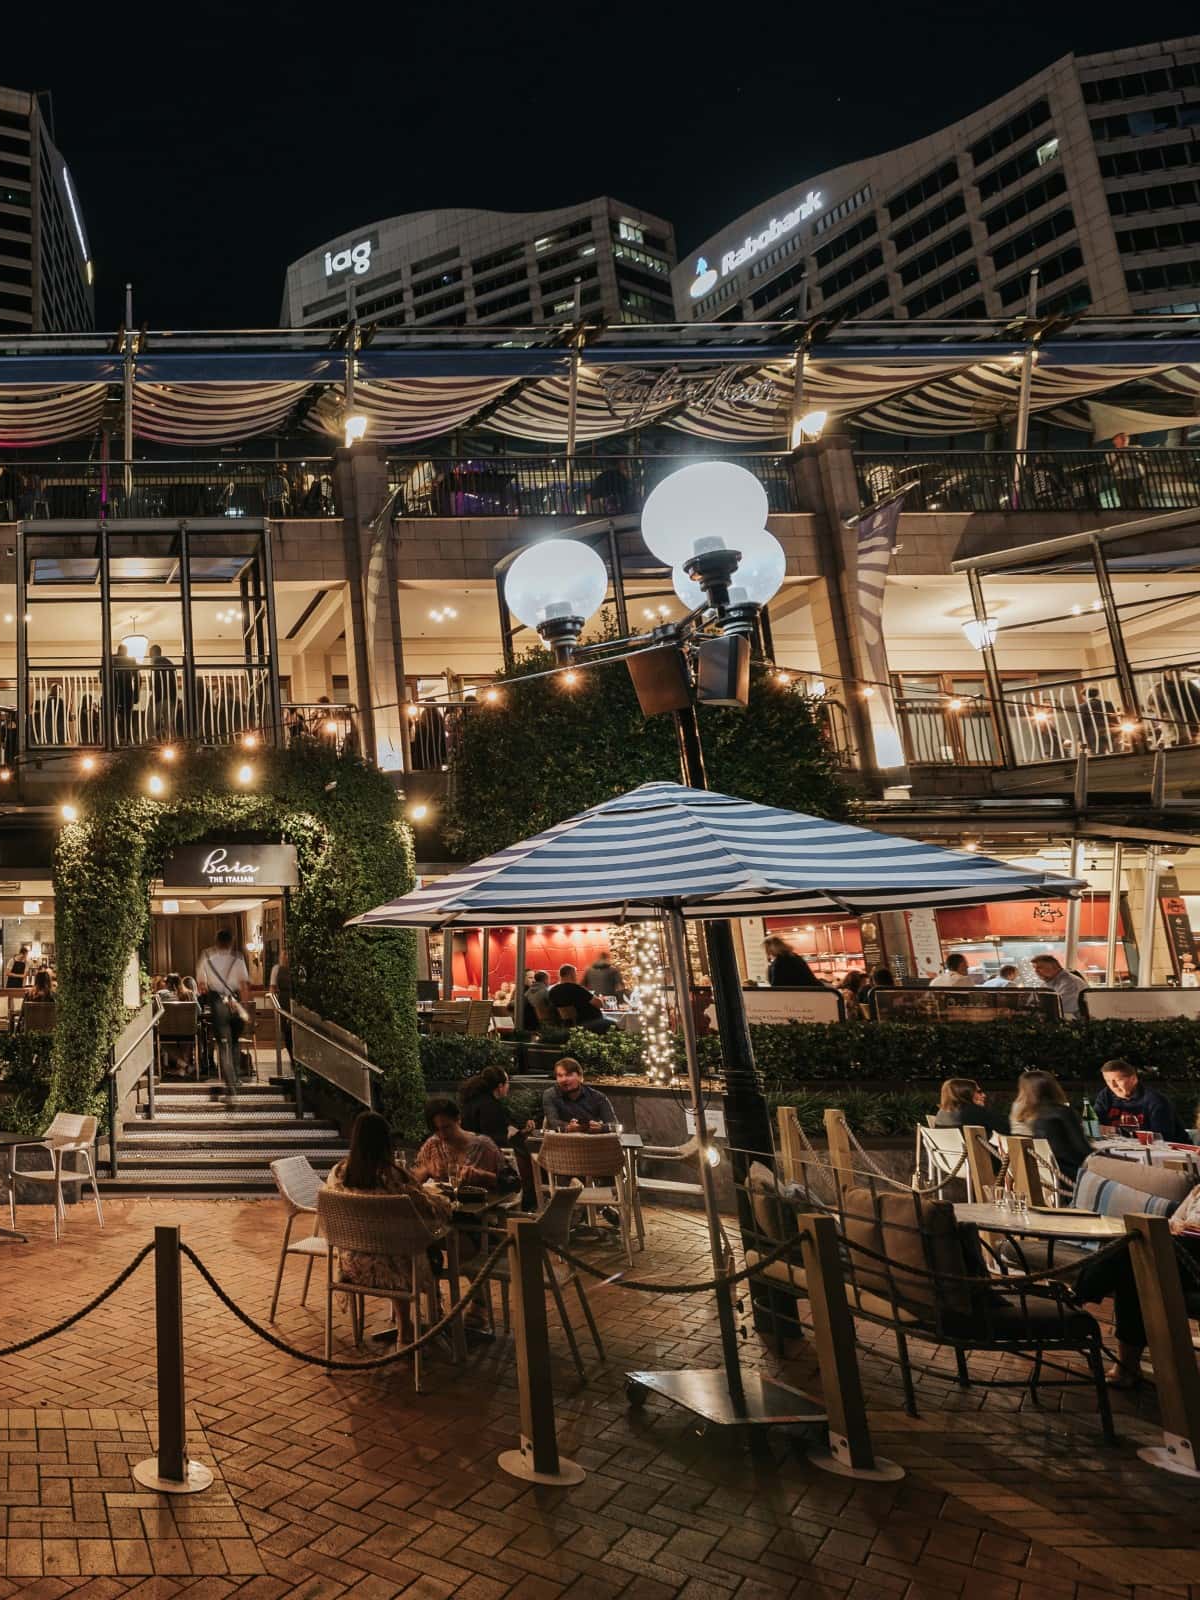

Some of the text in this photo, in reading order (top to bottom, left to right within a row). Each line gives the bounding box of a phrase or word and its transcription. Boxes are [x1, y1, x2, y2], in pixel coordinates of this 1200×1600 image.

[721, 191, 823, 277] Rabobank
[325, 240, 371, 277] iag
[201, 848, 261, 874] Baia
